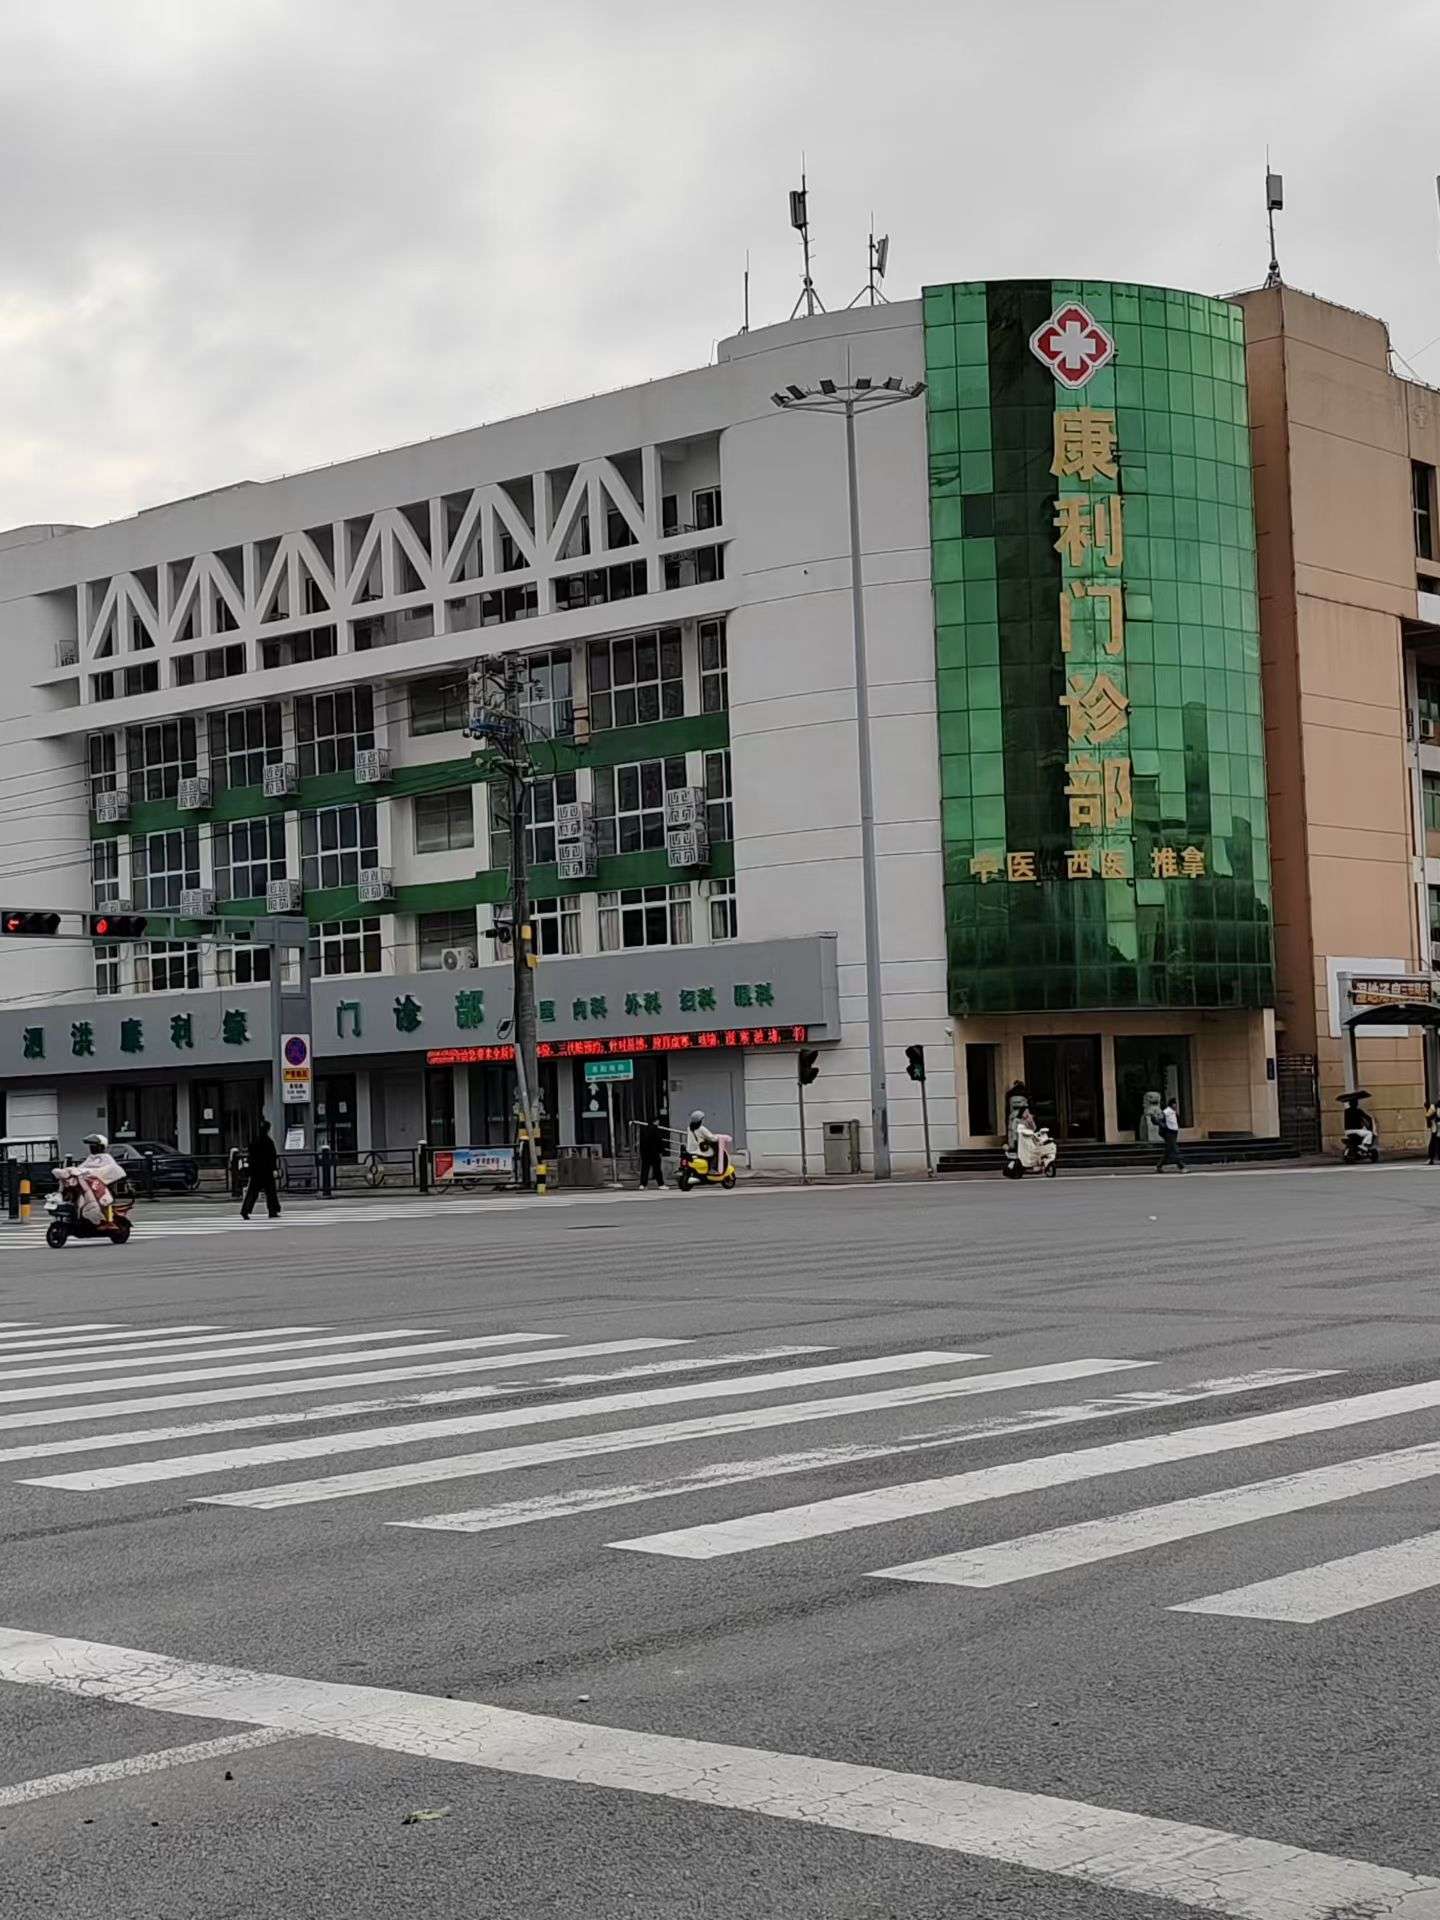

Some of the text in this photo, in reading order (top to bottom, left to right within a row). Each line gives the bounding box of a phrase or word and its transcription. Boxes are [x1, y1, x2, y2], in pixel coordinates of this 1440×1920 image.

[1050, 408, 1133, 828] 康利门诊部
[970, 846, 1206, 883] 中医 西医 推拿
[573, 995, 608, 1021] 内科
[625, 991, 662, 1016] 外科
[733, 982, 774, 1008] 眼科
